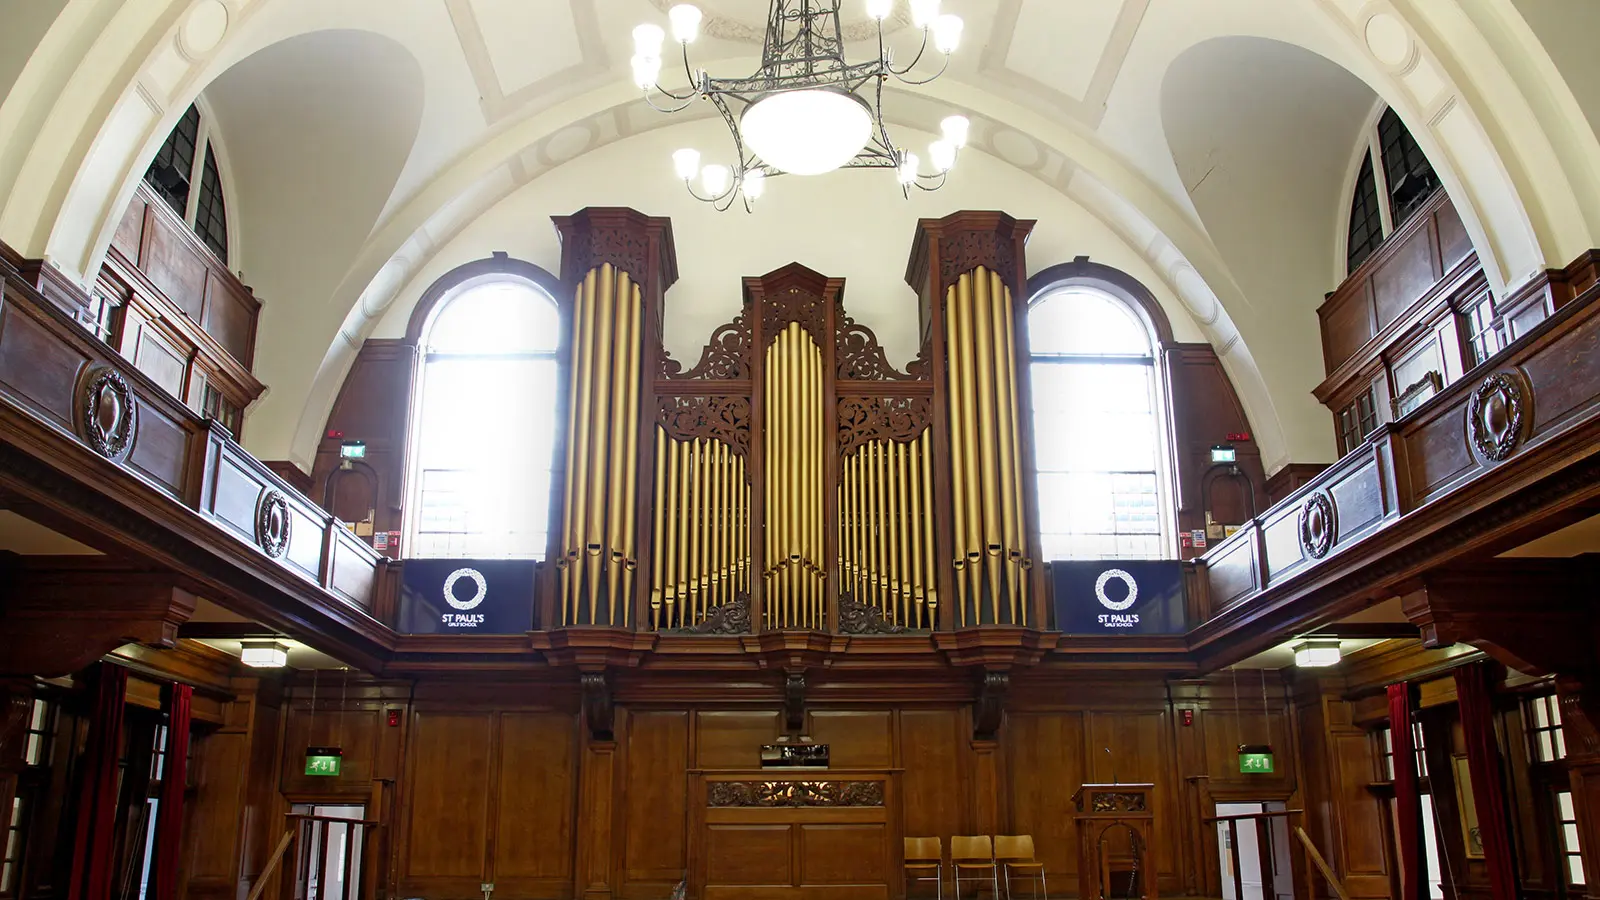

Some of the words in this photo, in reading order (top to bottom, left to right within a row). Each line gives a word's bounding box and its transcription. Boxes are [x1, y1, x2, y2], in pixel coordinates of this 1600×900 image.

[442, 613, 454, 623] ST
[455, 613, 485, 623] PAUL'S
[1098, 614, 1109, 623] ST
[1111, 614, 1139, 623] PAUL'S
